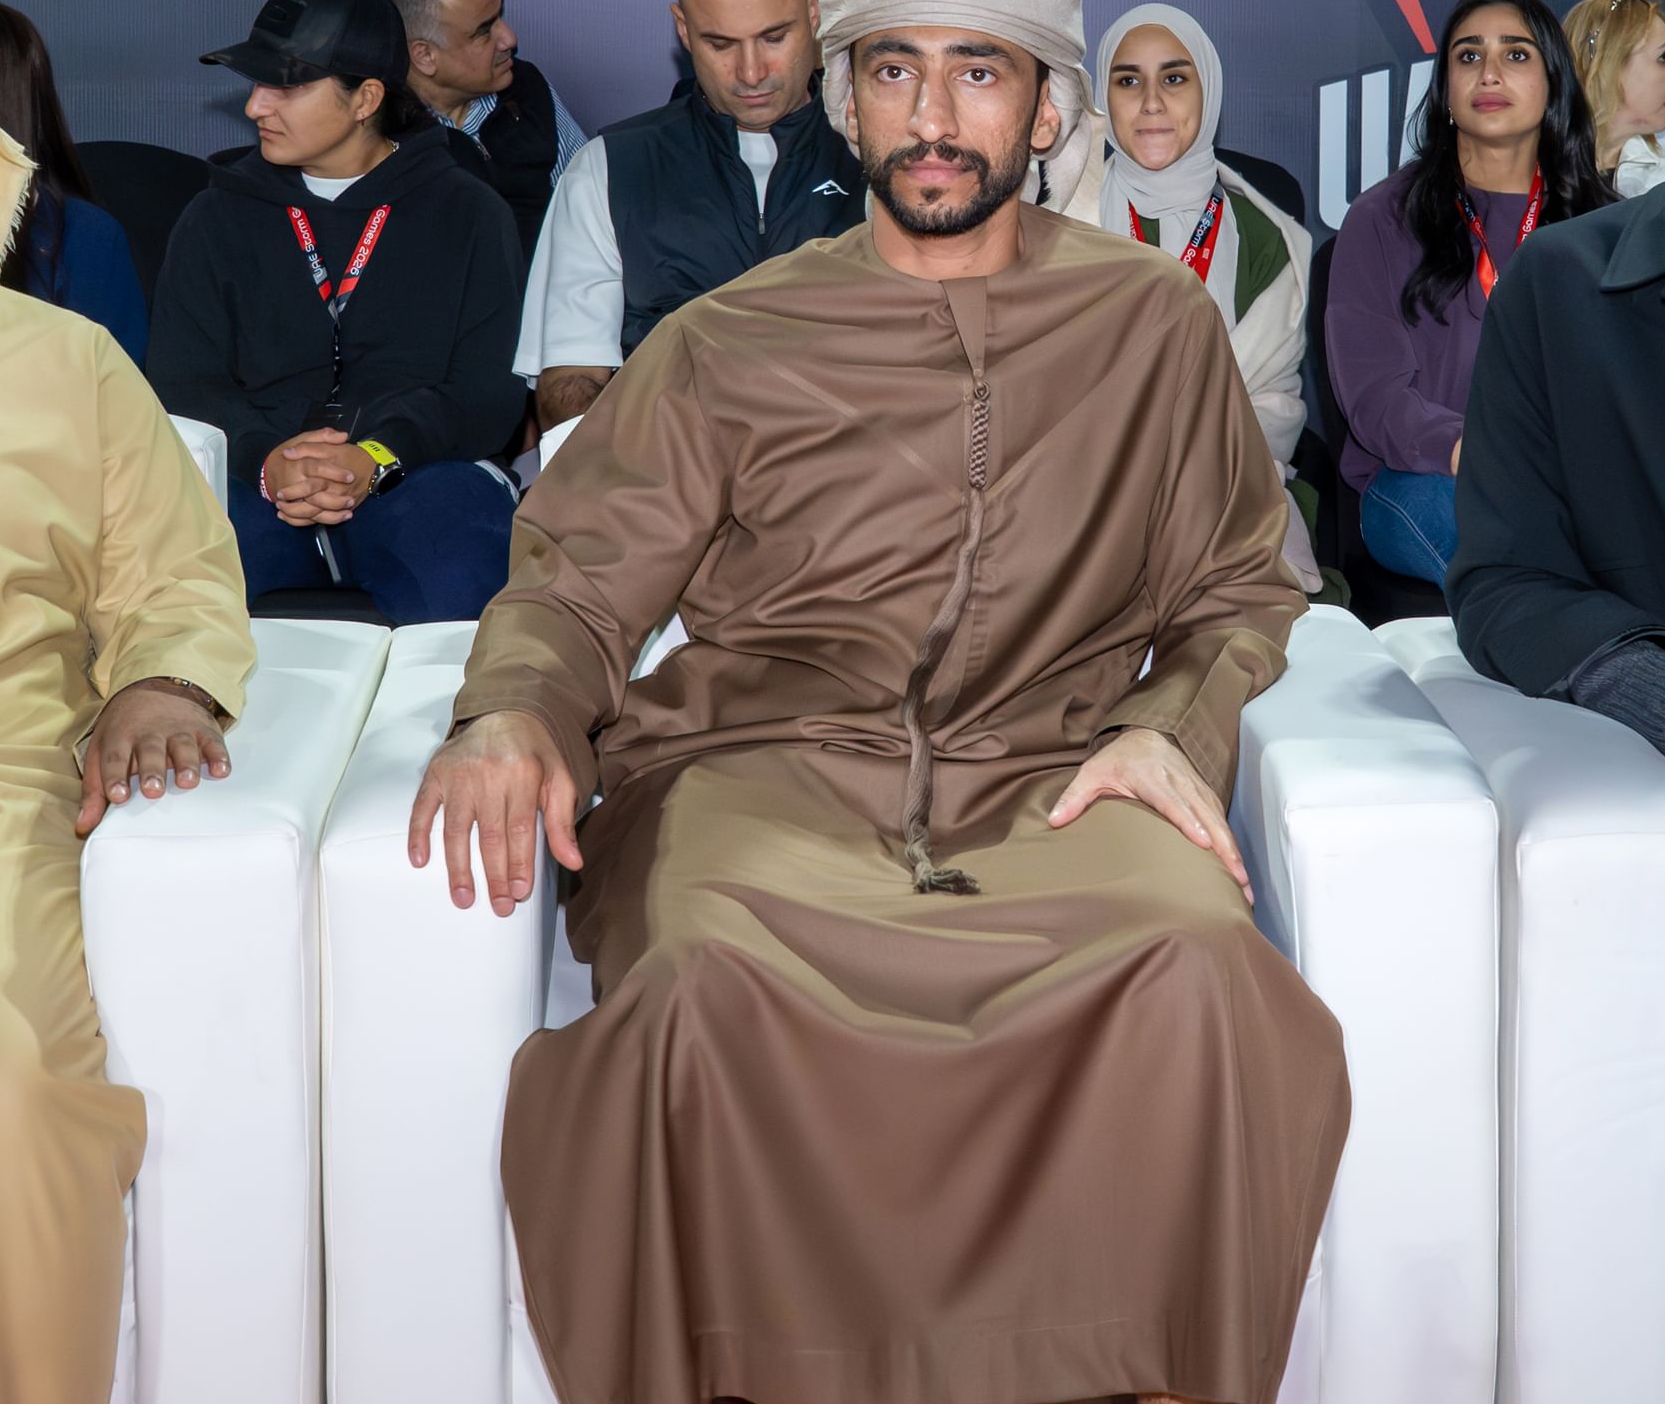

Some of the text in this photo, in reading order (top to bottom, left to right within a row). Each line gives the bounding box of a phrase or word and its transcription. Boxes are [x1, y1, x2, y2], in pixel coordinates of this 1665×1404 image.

[297, 218, 324, 278] UAE Storm
[350, 209, 386, 276] Games 2026
[1191, 217, 1211, 248] Storm
